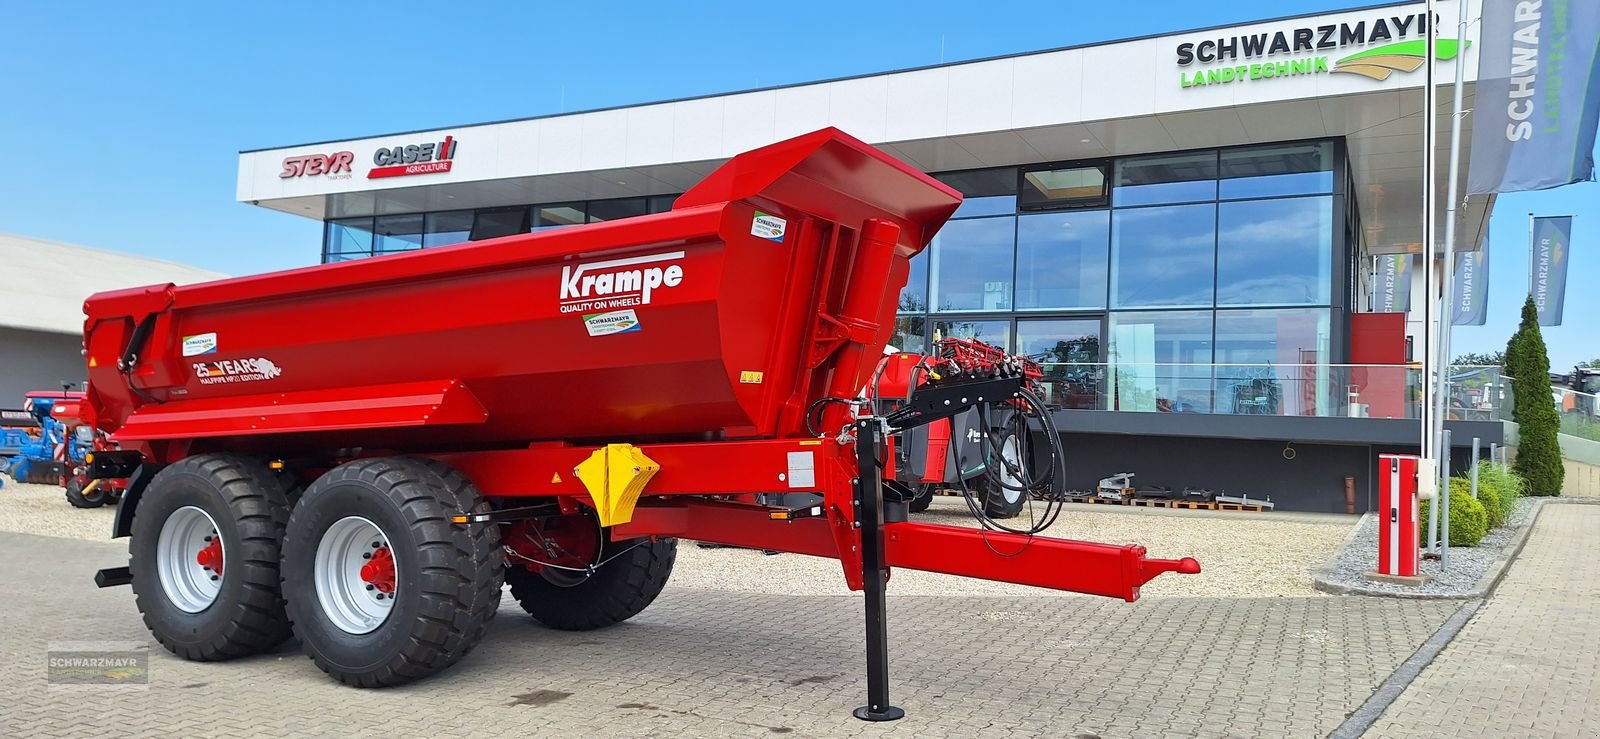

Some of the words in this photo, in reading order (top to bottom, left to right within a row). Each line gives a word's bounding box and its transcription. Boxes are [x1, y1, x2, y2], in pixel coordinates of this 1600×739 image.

[1176, 12, 1440, 66] SCHWARZMAYR
[1180, 55, 1330, 89] LANDTECHNIK
[279, 151, 355, 179] STEYR
[373, 143, 435, 167] CASE
[405, 162, 448, 175] AGRICULTURE
[559, 250, 685, 305] Krampe
[1536, 238, 1550, 312] SCHWARZMAYR
[559, 302, 593, 314] QUALITY
[594, 301, 608, 310] ON
[608, 297, 641, 308] WHEELS
[588, 315, 630, 325] SCHWARZMAYR
[193, 363, 209, 377] 25
[213, 358, 259, 375] YEARS
[200, 376, 226, 384] HALFPIPE
[240, 373, 265, 381] EDITION
